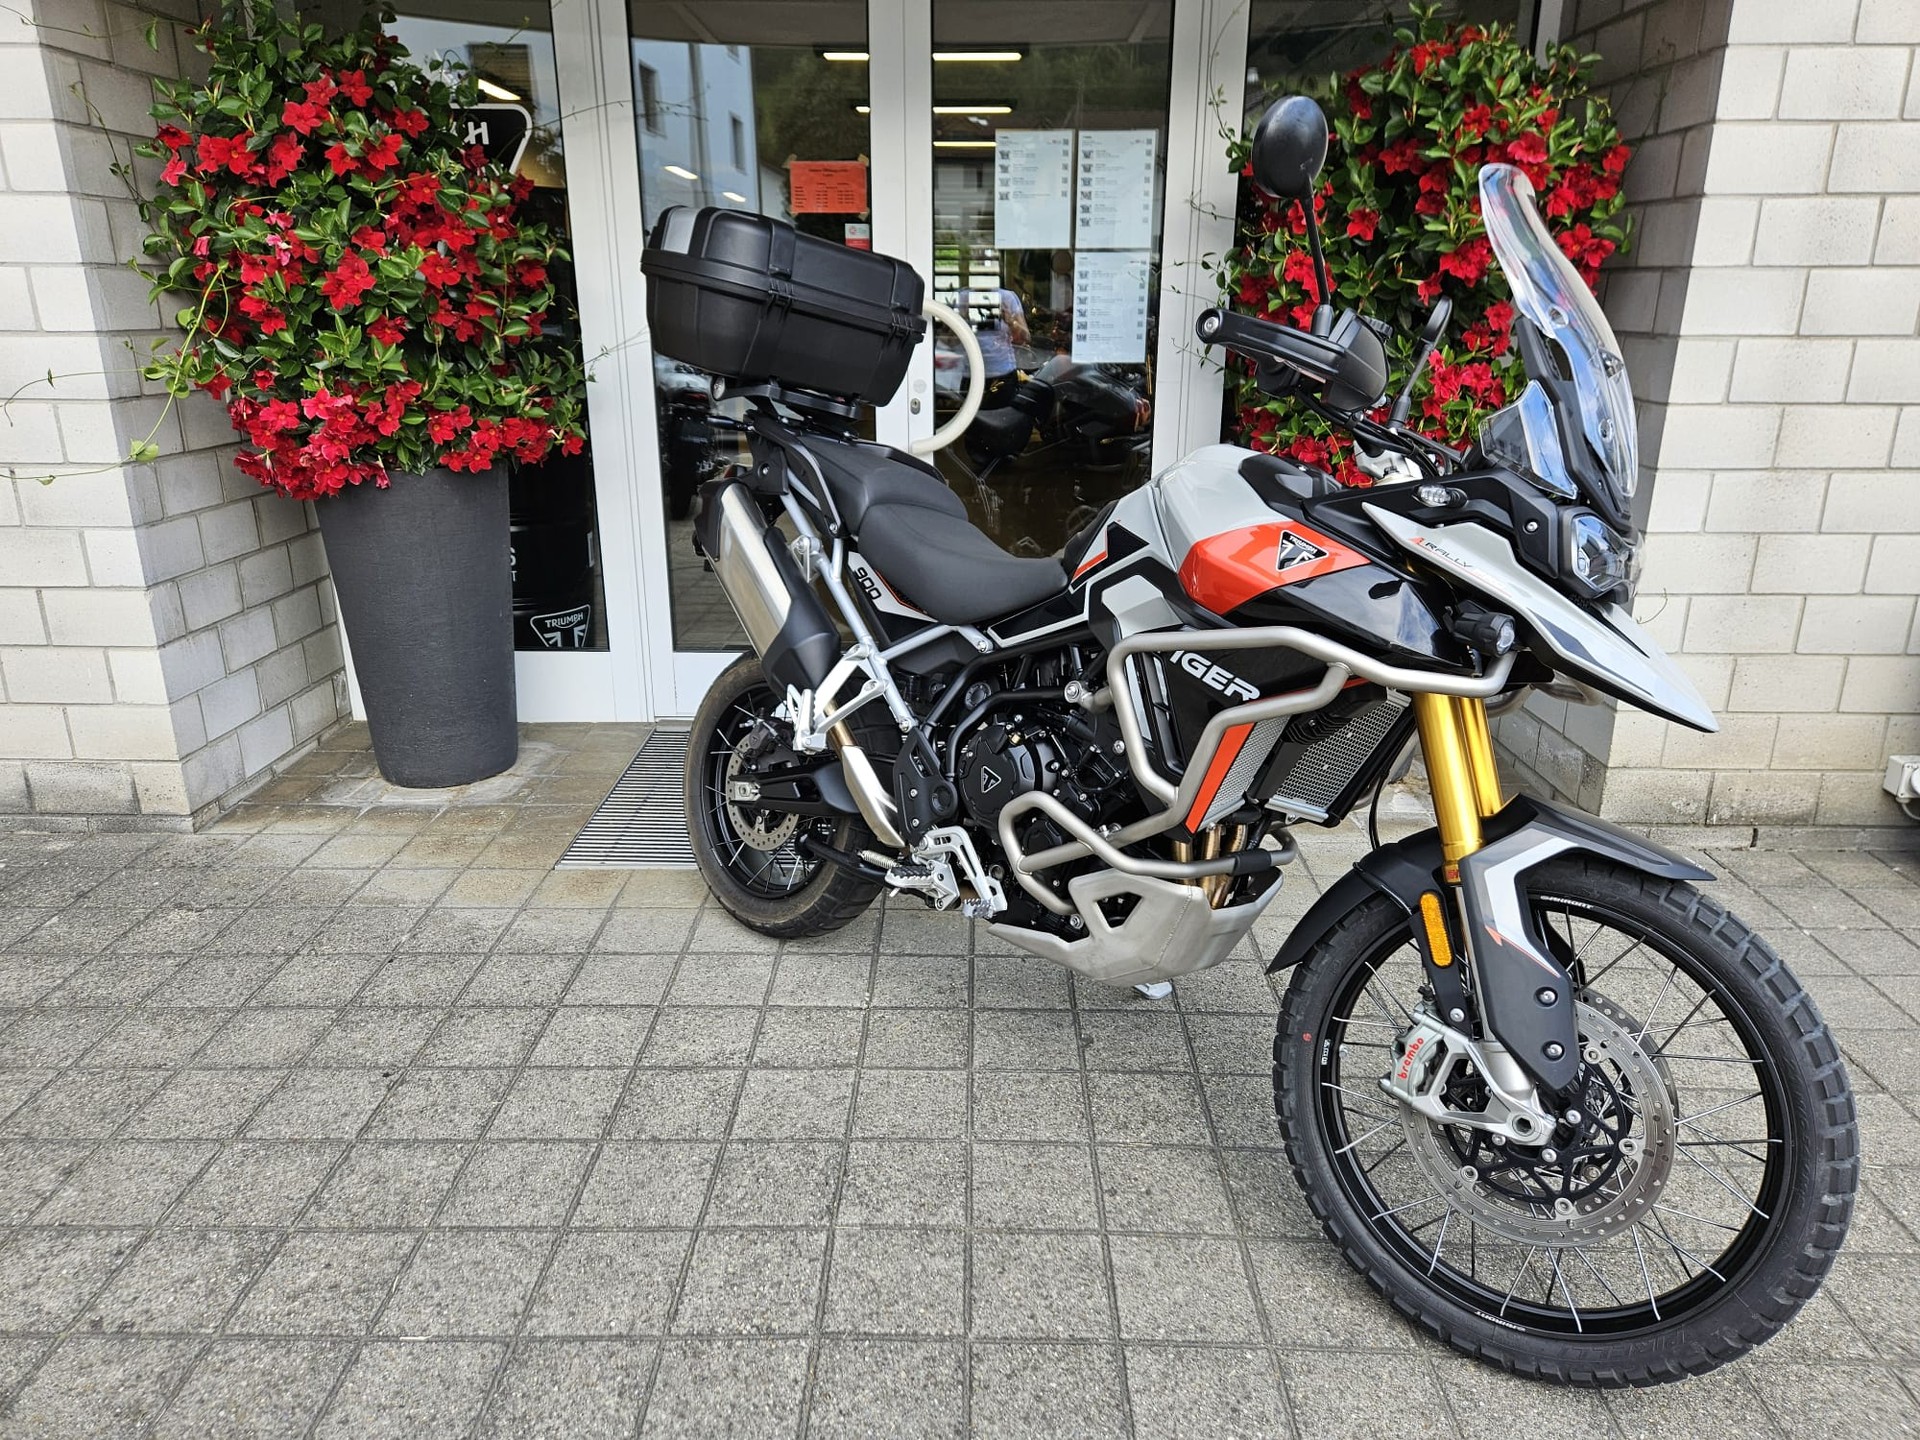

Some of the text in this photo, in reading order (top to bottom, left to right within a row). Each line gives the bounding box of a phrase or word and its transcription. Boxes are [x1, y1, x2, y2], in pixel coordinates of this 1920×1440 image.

[1289, 535, 1318, 554] TRIUMPH
[1425, 541, 1473, 568] RALLY
[855, 567, 882, 600] 900
[545, 612, 584, 628] TRIUMPH
[1169, 650, 1260, 702] IGER
[1397, 1037, 1424, 1079] brembo
